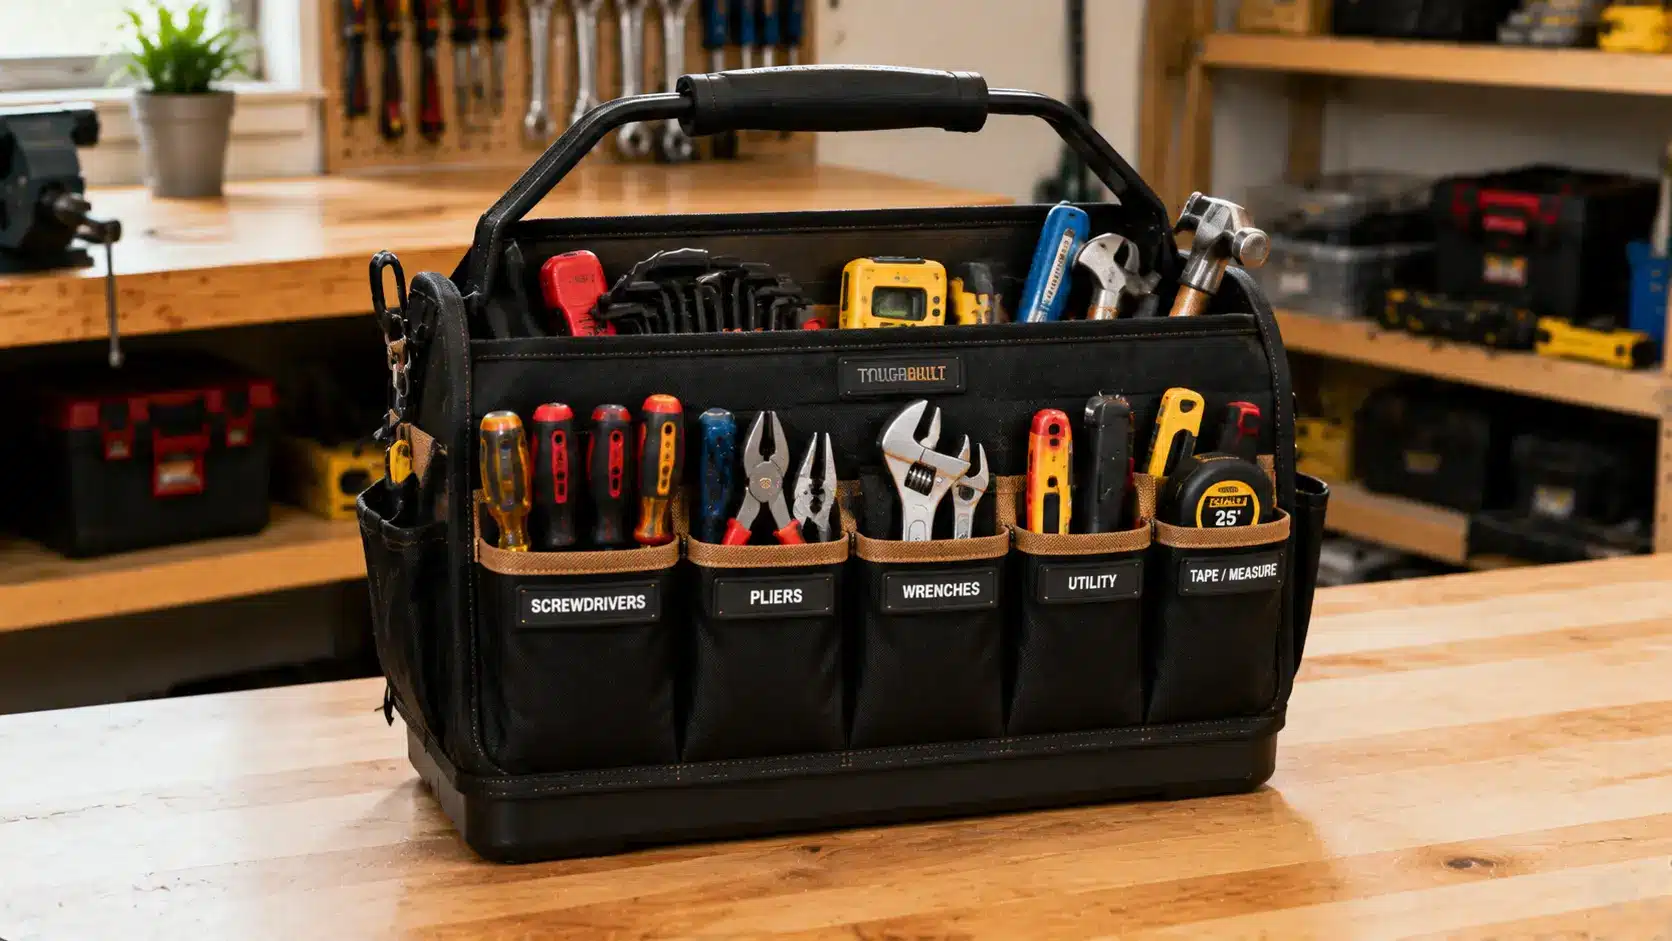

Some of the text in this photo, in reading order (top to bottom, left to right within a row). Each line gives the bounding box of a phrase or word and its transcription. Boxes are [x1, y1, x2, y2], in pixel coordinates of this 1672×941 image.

[1215, 509, 1241, 526] 25'
[1190, 562, 1278, 583] TAPE / MEASURE
[902, 581, 981, 599] WRENCHES
[1068, 573, 1118, 591] UTILITY
[531, 594, 646, 614] SCREWDRIVERS
[750, 588, 803, 605] PLIERS
